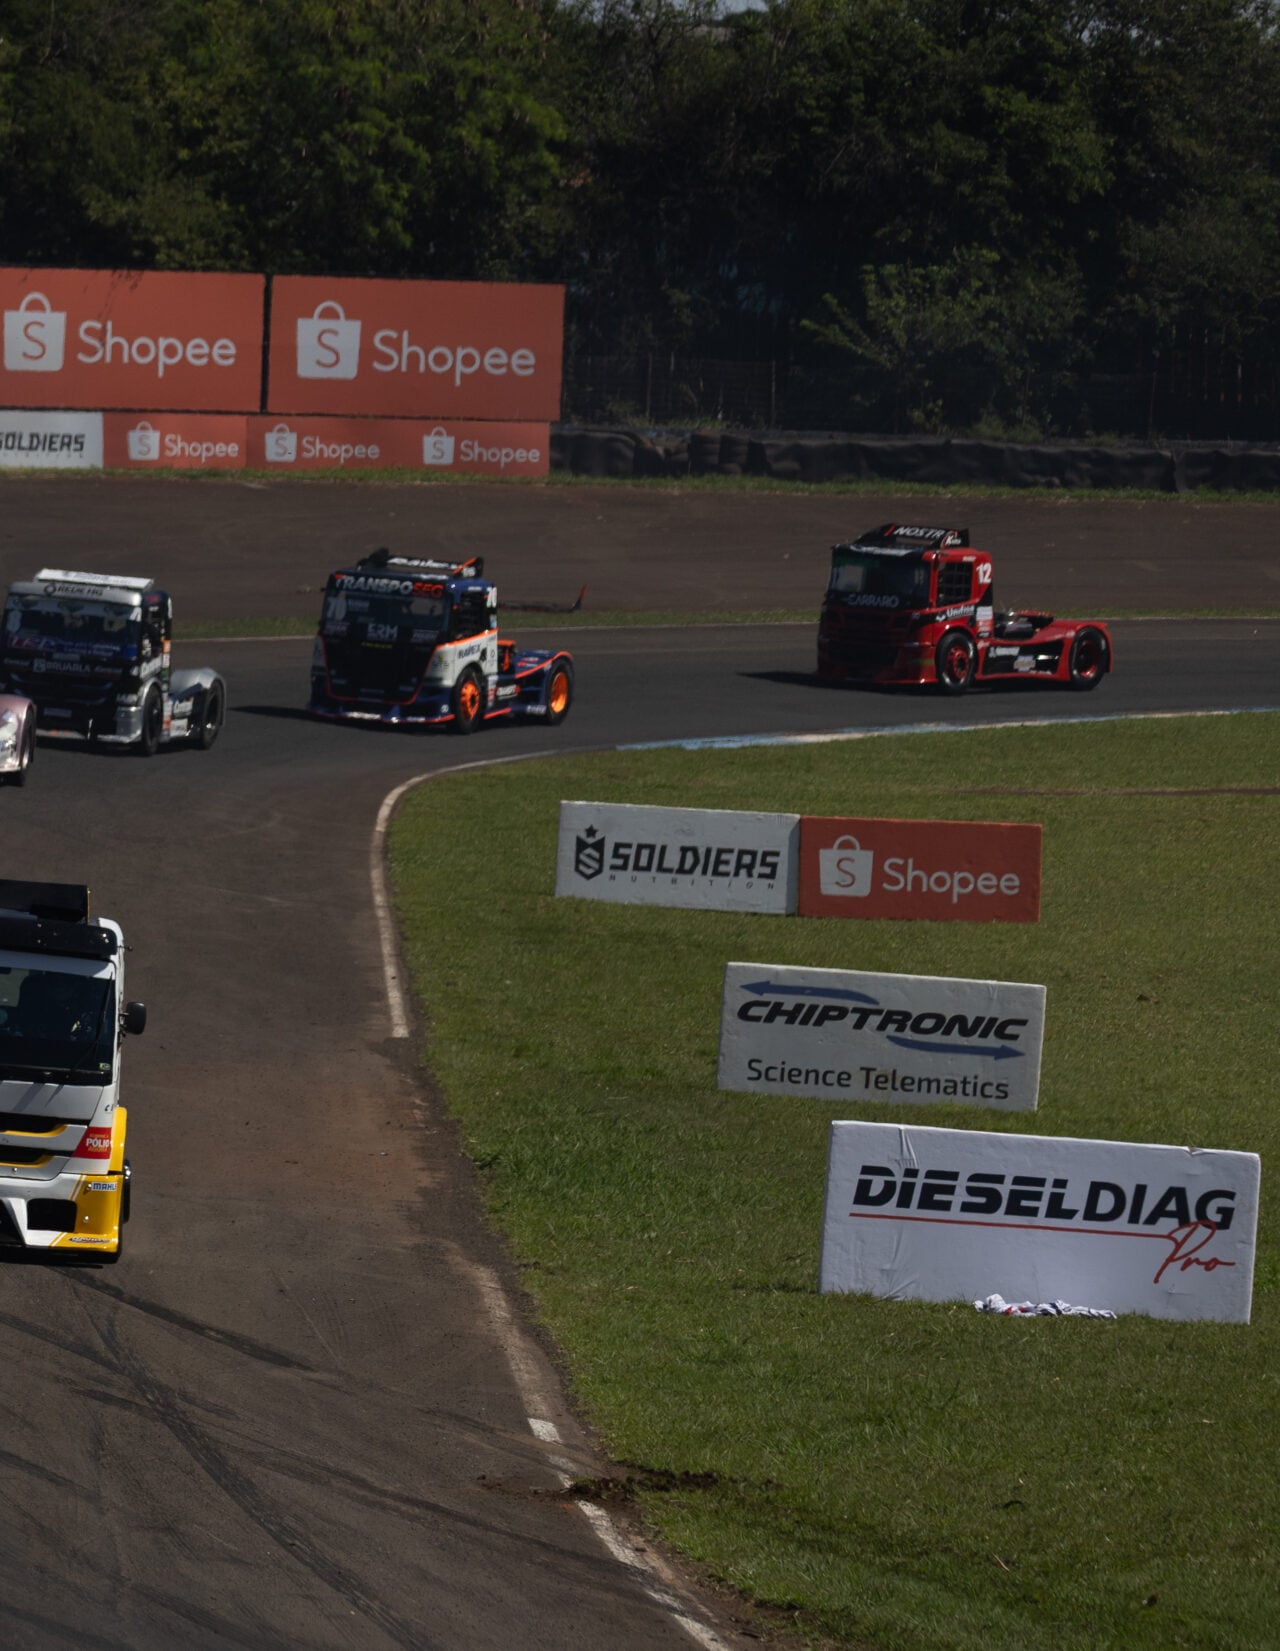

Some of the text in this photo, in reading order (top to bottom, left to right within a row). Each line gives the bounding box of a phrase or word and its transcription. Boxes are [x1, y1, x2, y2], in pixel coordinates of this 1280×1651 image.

[78, 320, 237, 378] Shopee
[372, 329, 536, 386] Shopee
[164, 433, 239, 460] Shopee
[302, 436, 380, 463] Shopee
[460, 440, 541, 467] Shopee
[893, 526, 946, 539] NOSTR
[976, 562, 992, 584] 12
[609, 842, 781, 880] SOLDIERS
[609, 874, 775, 891] NUTRITION
[882, 857, 1021, 904] Shopee
[736, 999, 1029, 1042] CHIPTRONIC
[747, 1058, 1010, 1101] Science Telematics
[92, 1182, 116, 1191] MAHL
[852, 1164, 1237, 1231] DIESELDIAG
[1153, 1219, 1236, 1284] Pro
